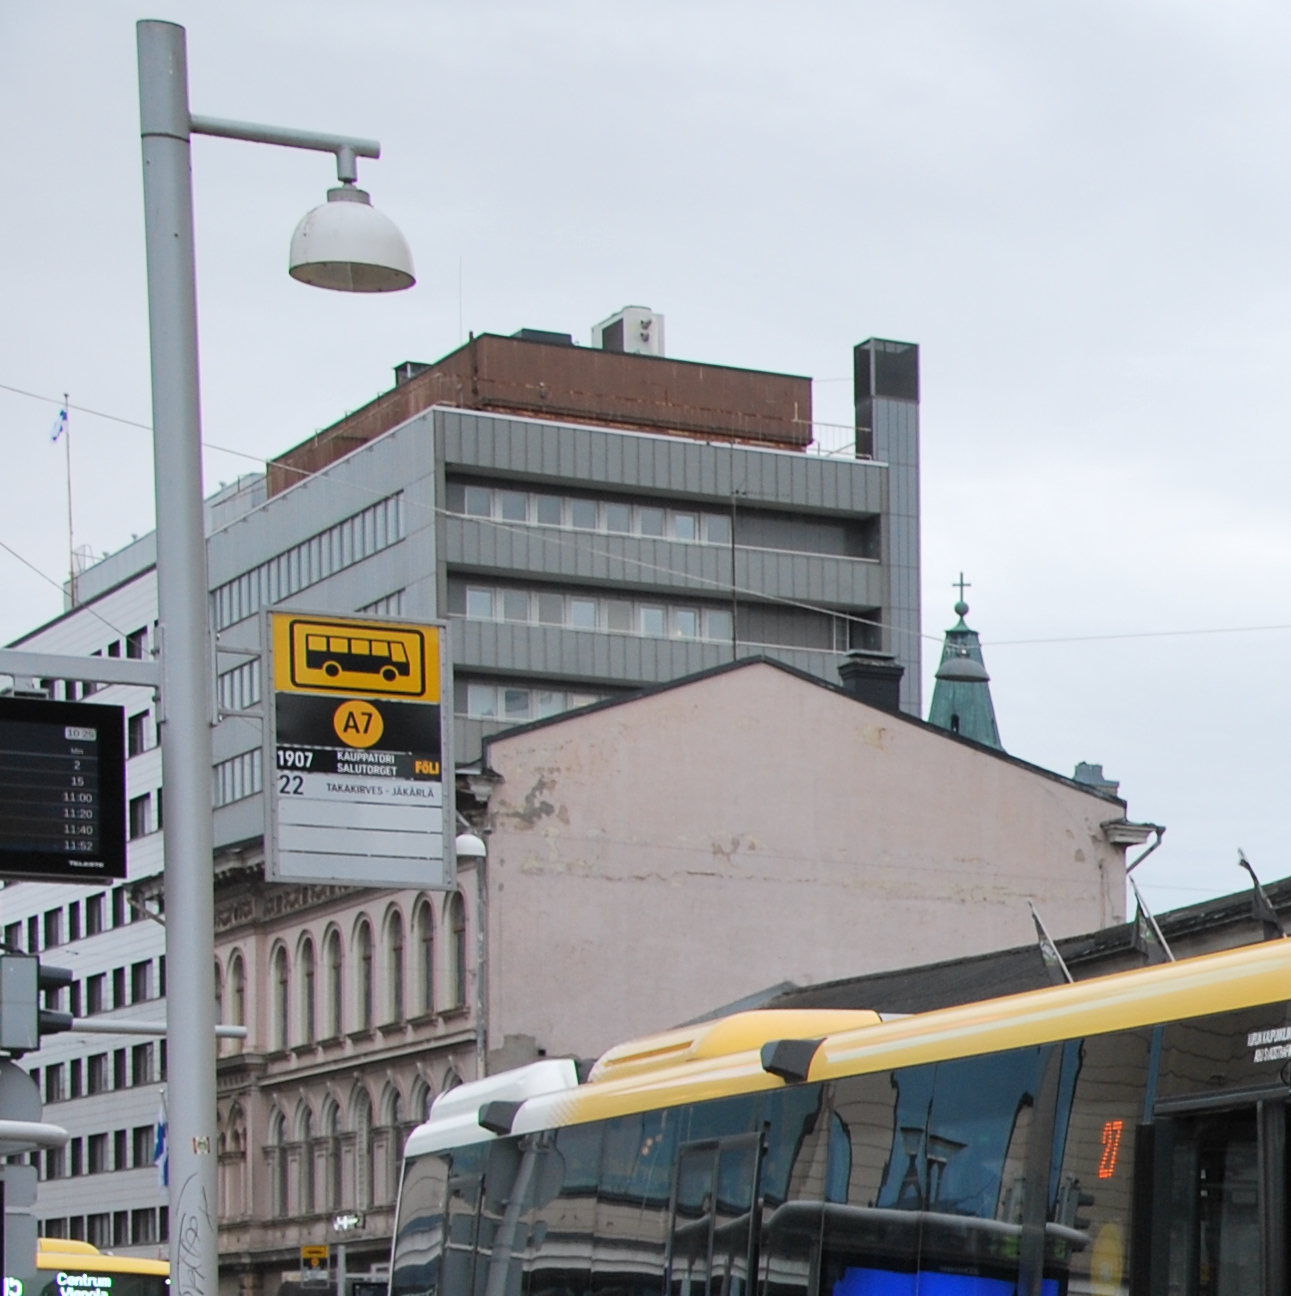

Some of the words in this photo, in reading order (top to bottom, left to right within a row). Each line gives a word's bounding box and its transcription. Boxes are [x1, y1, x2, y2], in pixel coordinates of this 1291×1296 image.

[343, 711, 373, 734] A7
[74, 760, 81, 770] 2
[277, 750, 313, 768] 1907
[337, 752, 395, 765] KAUPPATORI
[337, 763, 397, 776] SALUTORGET
[414, 760, 439, 774] FÖLI
[71, 776, 84, 787] 15
[279, 774, 304, 795] 22
[326, 782, 383, 796] TAKAKIRVES
[63, 792, 93, 803] 11:00
[63, 808, 93, 819] 11:20
[64, 824, 94, 835] 11:40
[1098, 1120, 1122, 1178] 27
[56, 1272, 112, 1287] Centrum
